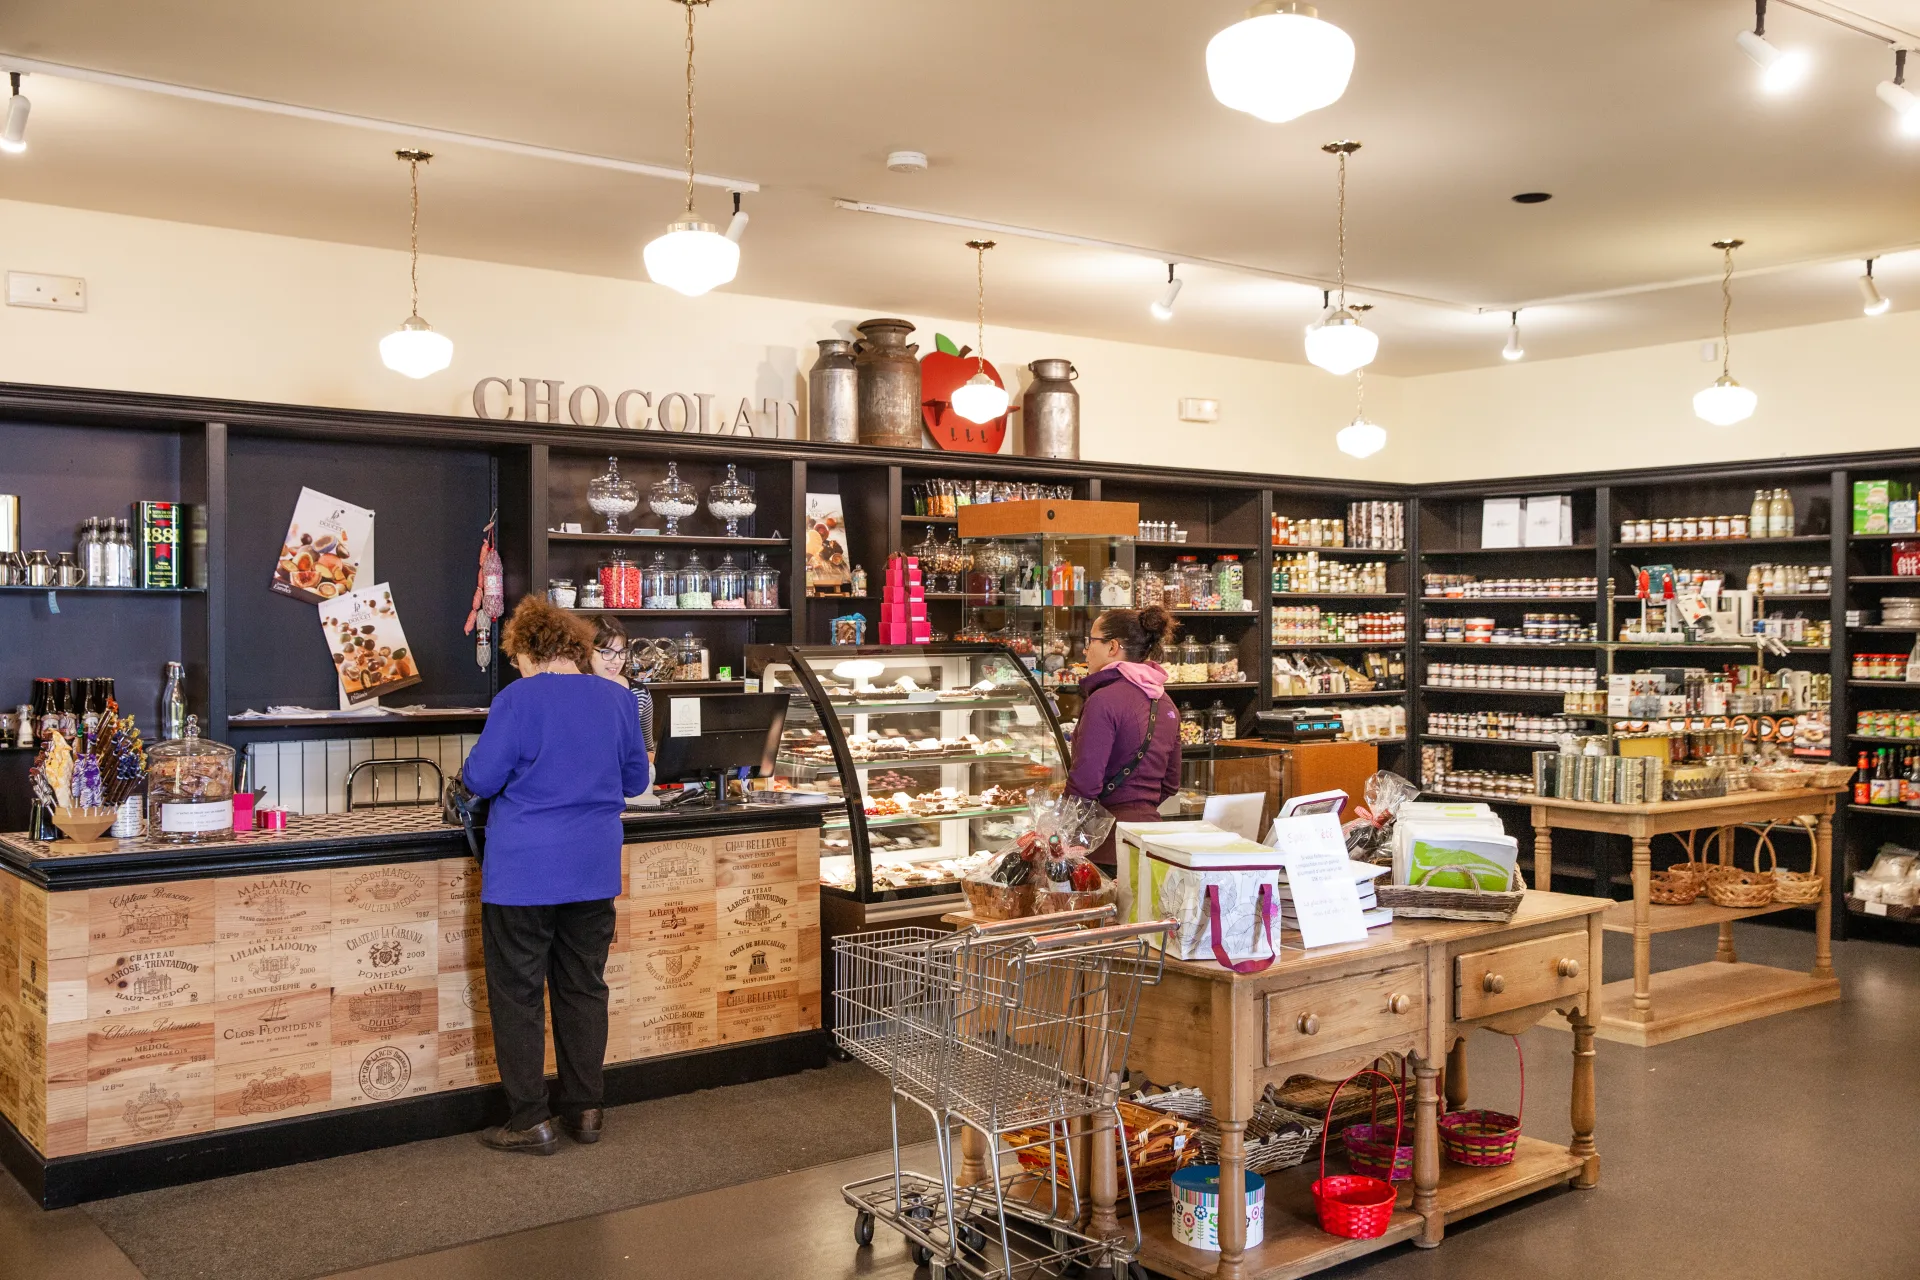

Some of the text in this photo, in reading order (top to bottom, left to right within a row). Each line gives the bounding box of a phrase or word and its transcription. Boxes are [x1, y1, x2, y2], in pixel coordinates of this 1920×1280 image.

[472, 376, 799, 438] CHOCOLAT
[319, 520, 344, 532] DOUCET
[144, 527, 180, 543] 1881
[348, 613, 372, 624] DOUCET
[746, 837, 787, 850] BELLEVUE
[639, 842, 708, 864] CHATEAU CORBIN
[344, 868, 426, 895] CLOS DU MARQUIS
[238, 879, 312, 898] MALARTIC
[743, 887, 772, 895] CHATEAU
[358, 902, 391, 913] JULIEN
[727, 894, 788, 913] LAROSE-TRINTAUDON
[346, 926, 424, 951] CHATEAU LA CABANNE
[129, 950, 175, 962] CHATEAU
[230, 942, 318, 963] LILIAN LADOUYS
[406, 950, 426, 959] 2003
[730, 944, 746, 957] CROIX
[104, 959, 199, 986] LAROSE-TRINTAUDON
[300, 967, 316, 975] 2000
[358, 964, 414, 980] POMEROL
[604, 964, 625, 974] RION
[364, 982, 407, 996] CHATEAU
[655, 981, 693, 991] MARGAUX
[747, 989, 788, 1004] BELLEVUE
[152, 1016, 201, 1032] Potensac
[368, 1016, 401, 1026] DULUC
[642, 1011, 705, 1028] LALANDE-BORIE
[224, 1028, 255, 1040] CLOS
[140, 1048, 188, 1059] BOURGEOIS
[300, 1062, 316, 1070] 2002
